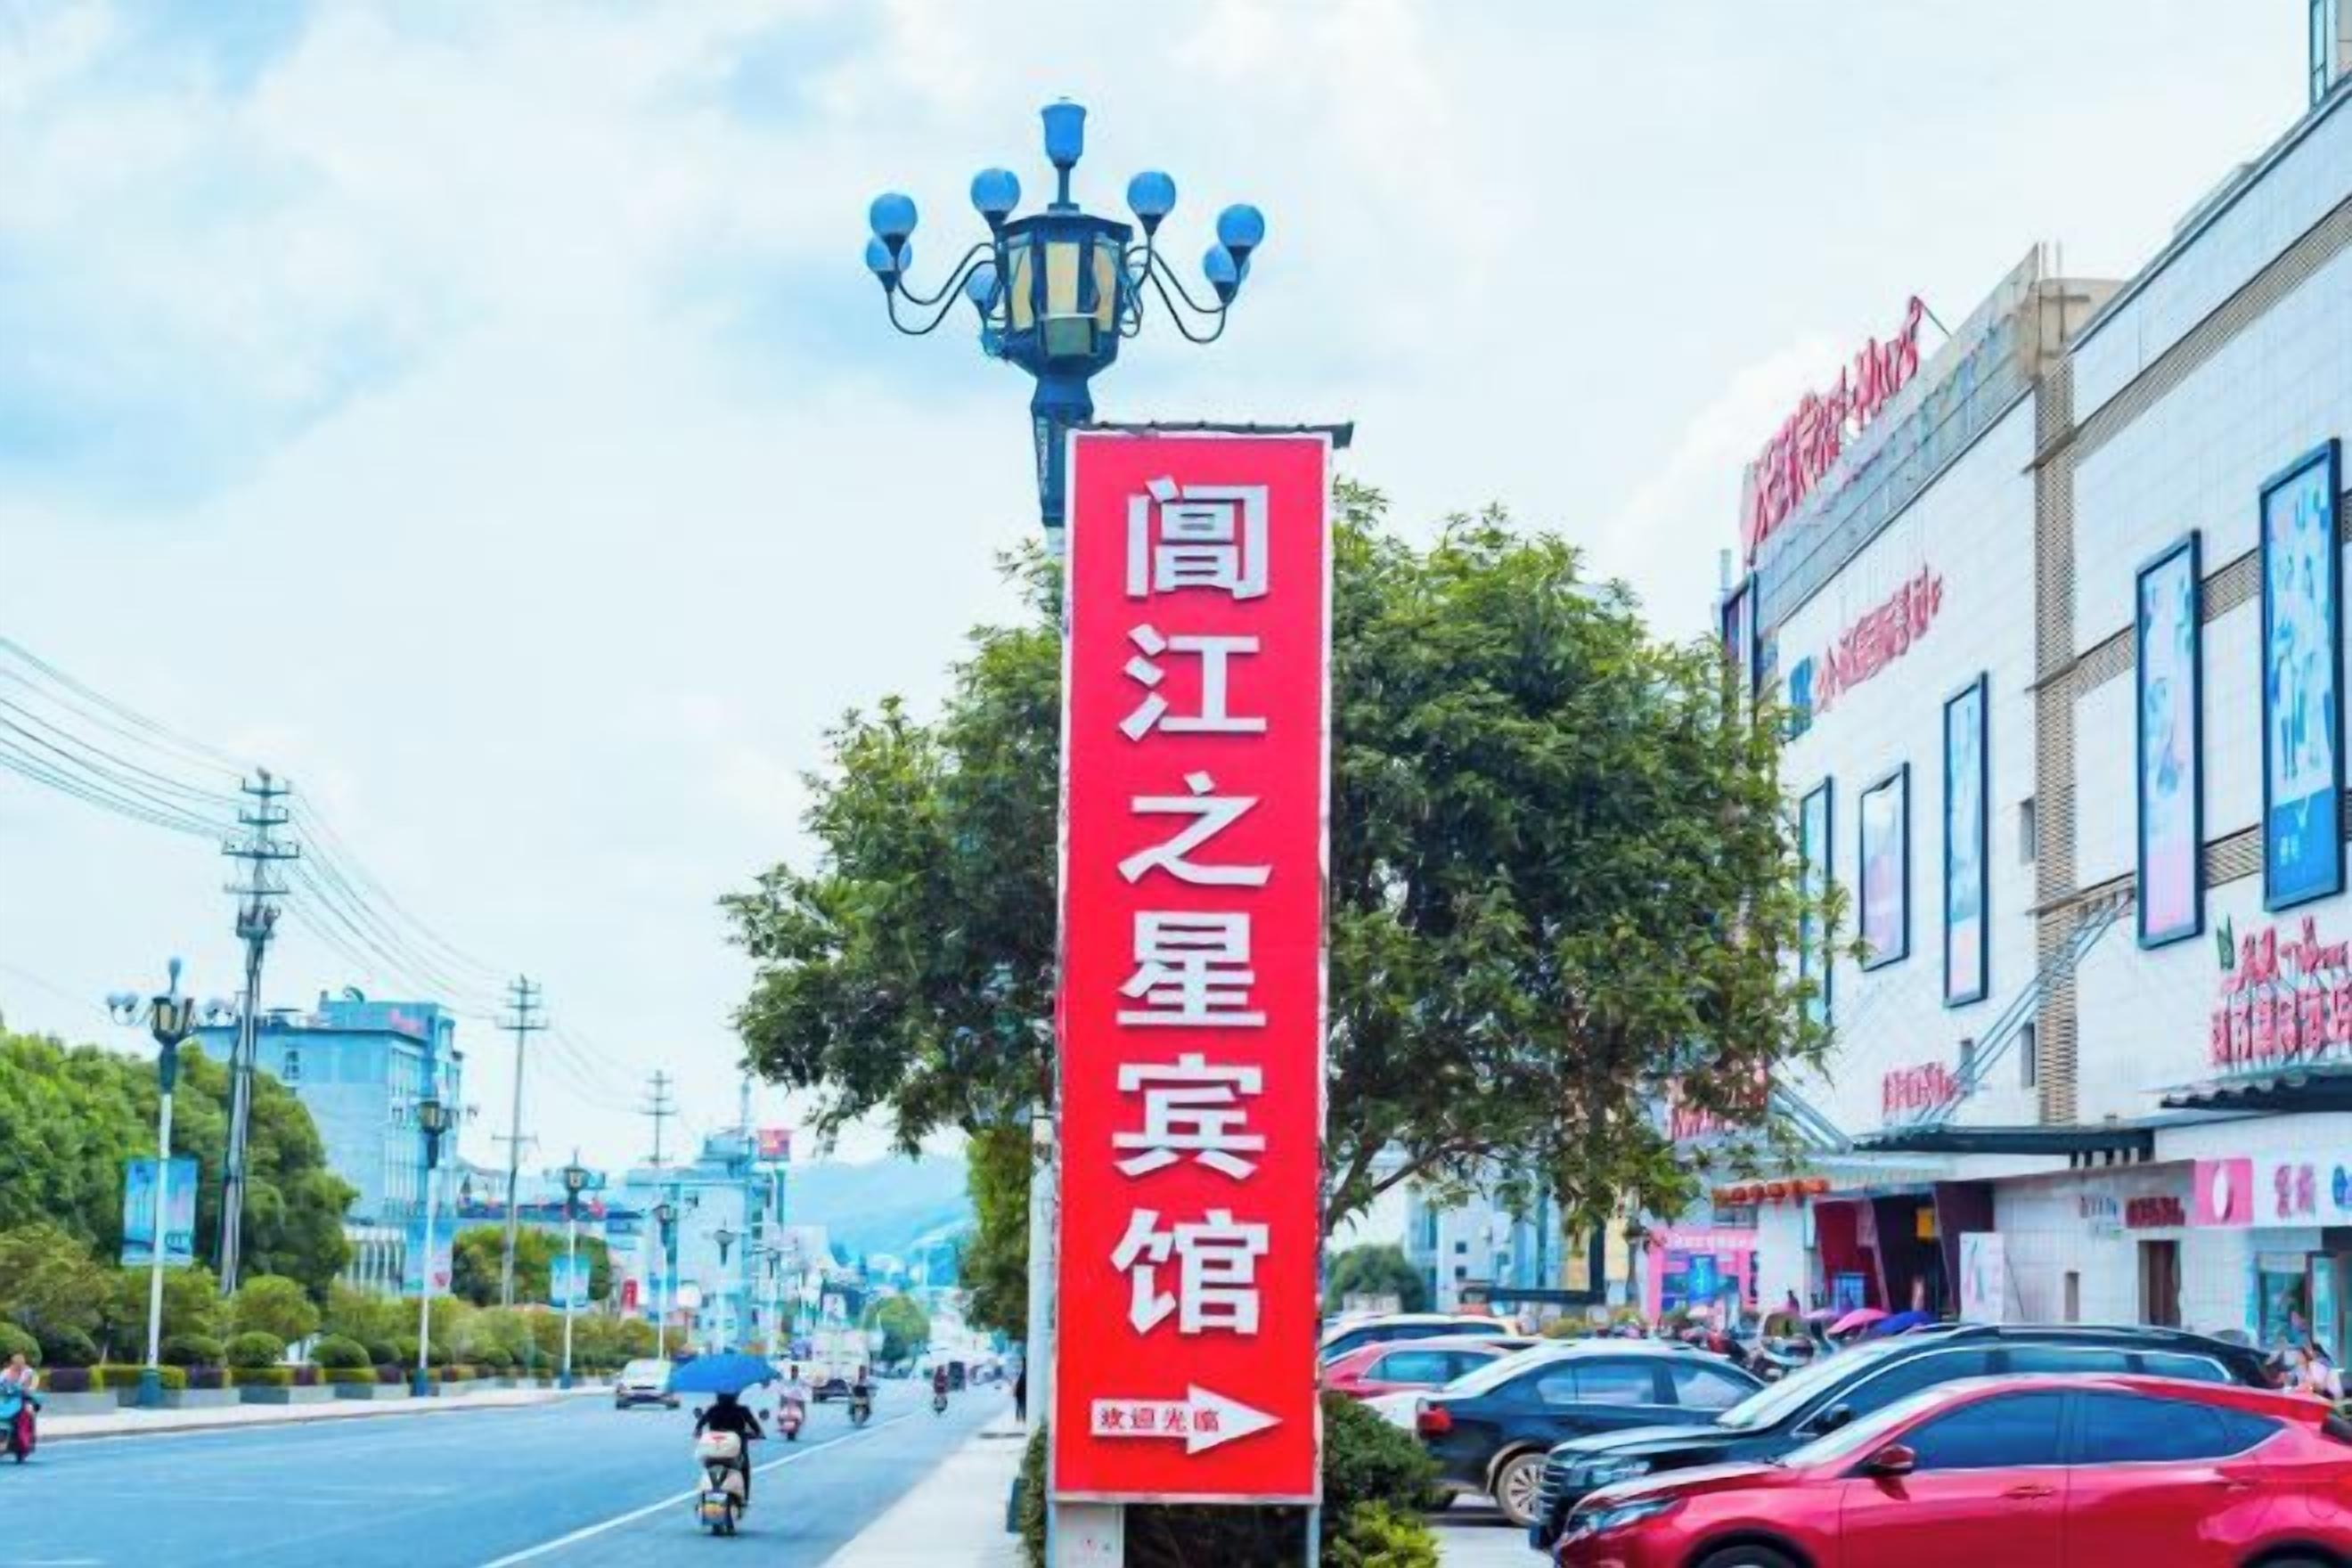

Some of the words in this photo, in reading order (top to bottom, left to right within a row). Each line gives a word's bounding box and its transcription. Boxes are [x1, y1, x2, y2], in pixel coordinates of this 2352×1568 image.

[1110, 475, 1271, 1335] 阊江之星宾馆
